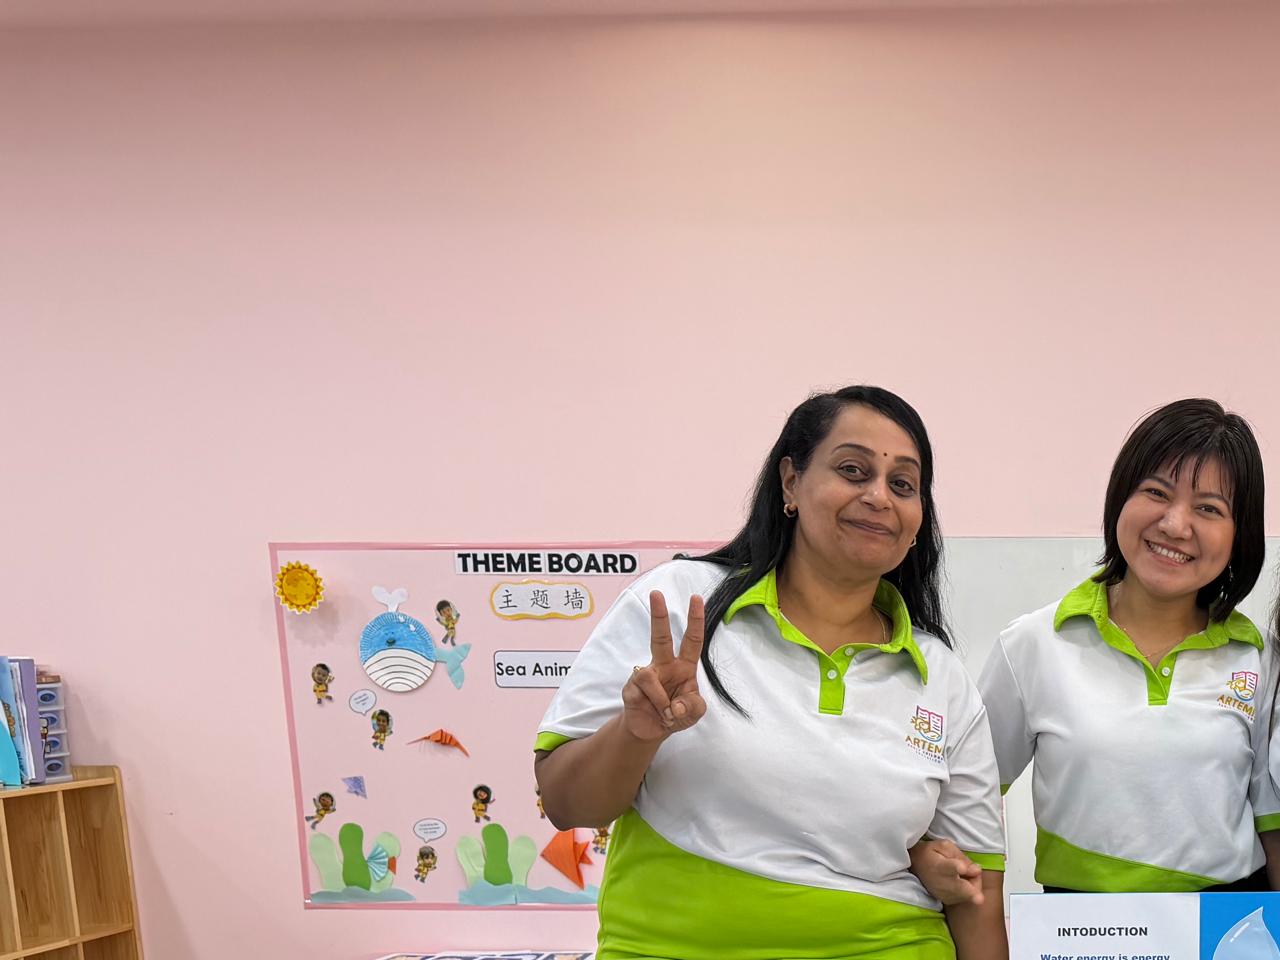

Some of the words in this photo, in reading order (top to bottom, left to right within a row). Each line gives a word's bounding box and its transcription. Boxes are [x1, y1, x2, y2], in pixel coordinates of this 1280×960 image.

[458, 553, 542, 573] THEME
[547, 553, 637, 573] BOARD
[499, 588, 585, 610] 主题墙
[496, 662, 526, 676] Sea
[1057, 927, 1148, 937] INTODUCTION
